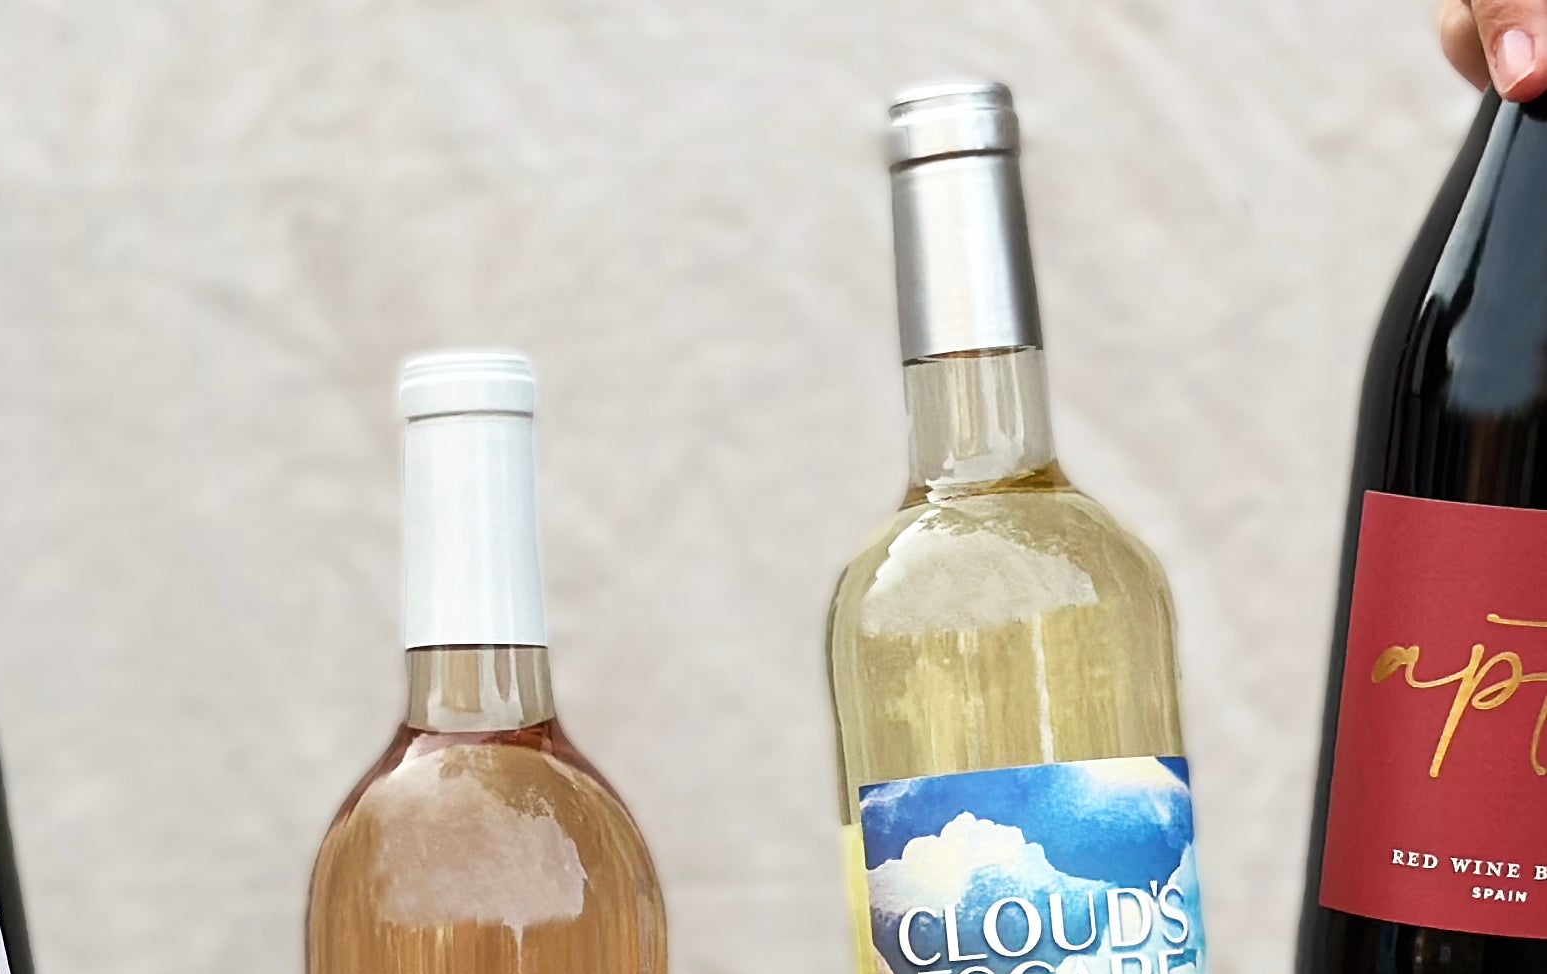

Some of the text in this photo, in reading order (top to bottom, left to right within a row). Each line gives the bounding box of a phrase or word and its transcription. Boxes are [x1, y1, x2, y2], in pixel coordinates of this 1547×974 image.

[1392, 849, 1438, 869] RED
[1450, 857, 1521, 879] WINE
[1472, 886, 1528, 902] SPAIN
[897, 880, 1189, 968] CLOUD'S
